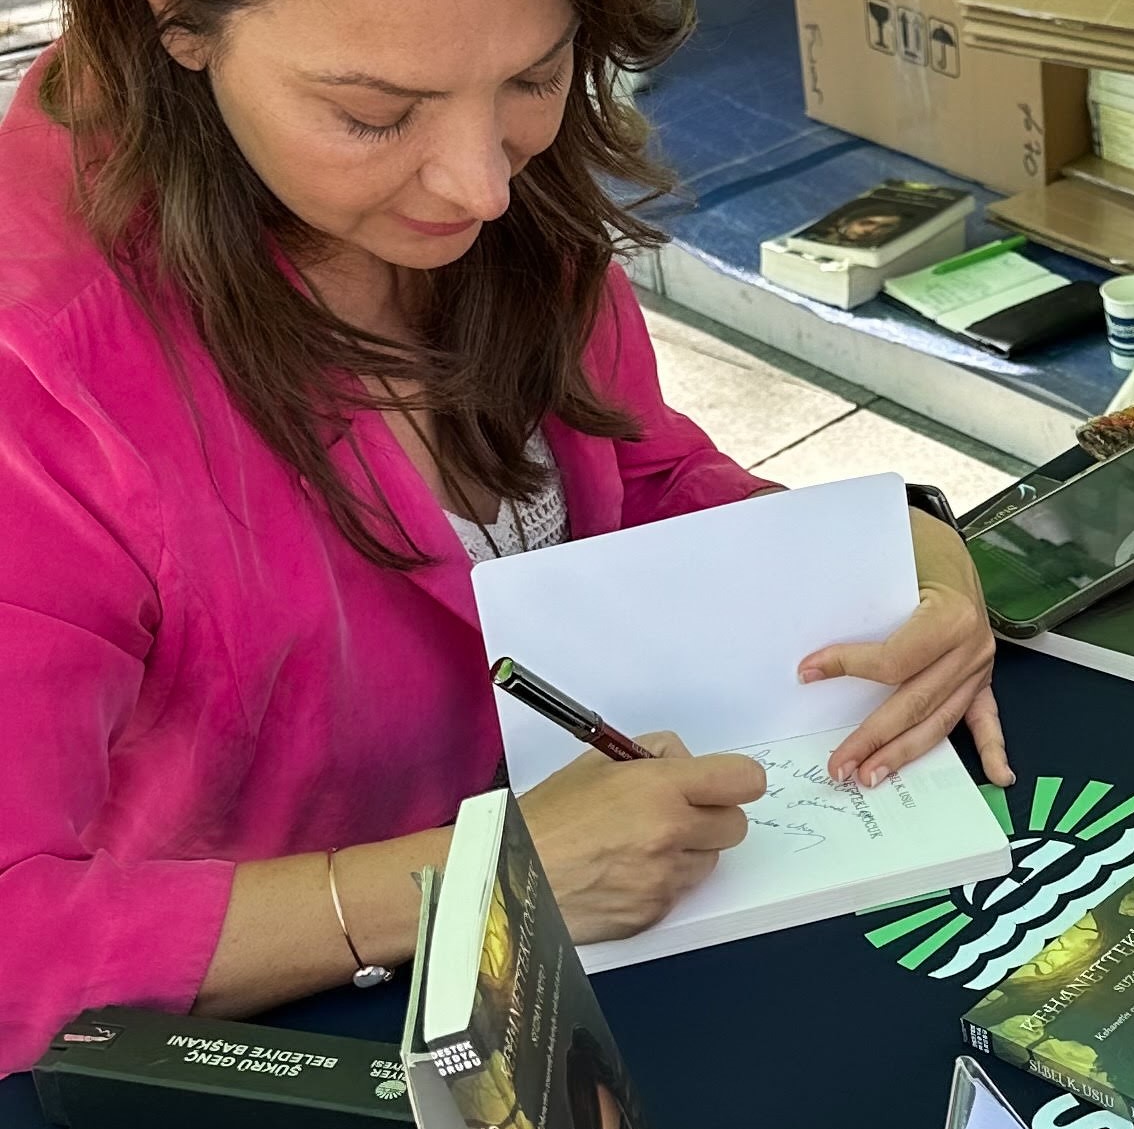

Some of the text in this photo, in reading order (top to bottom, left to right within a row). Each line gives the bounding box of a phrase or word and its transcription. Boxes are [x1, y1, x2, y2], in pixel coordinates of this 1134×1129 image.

[167, 1034, 339, 1069] BELEDİYE BAŞKANI
[184, 1049, 303, 1078] ŞÜKRÜ GENÇ
[431, 1040, 473, 1060] DESTEK
[435, 1049, 478, 1068] MEDYA
[1029, 1058, 1065, 1086] SİBEL
[1082, 1084, 1115, 1109] USLU
